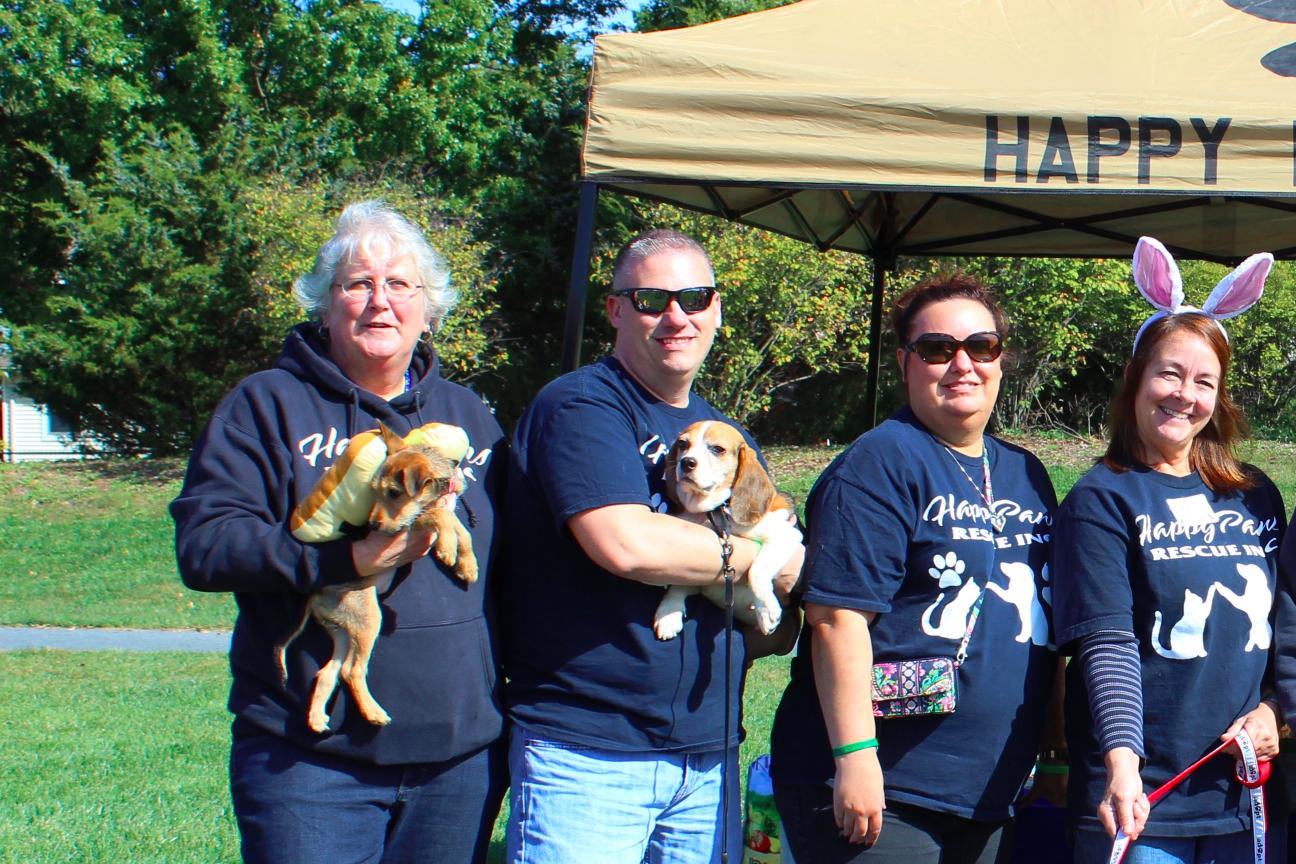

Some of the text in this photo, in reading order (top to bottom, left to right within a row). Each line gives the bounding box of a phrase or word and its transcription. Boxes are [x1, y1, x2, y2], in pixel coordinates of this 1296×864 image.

[983, 116, 1233, 185] HAPPY
[923, 493, 991, 527] Happ
[1135, 514, 1216, 547] Happy
[1150, 537, 1279, 561] RESCUE INC
